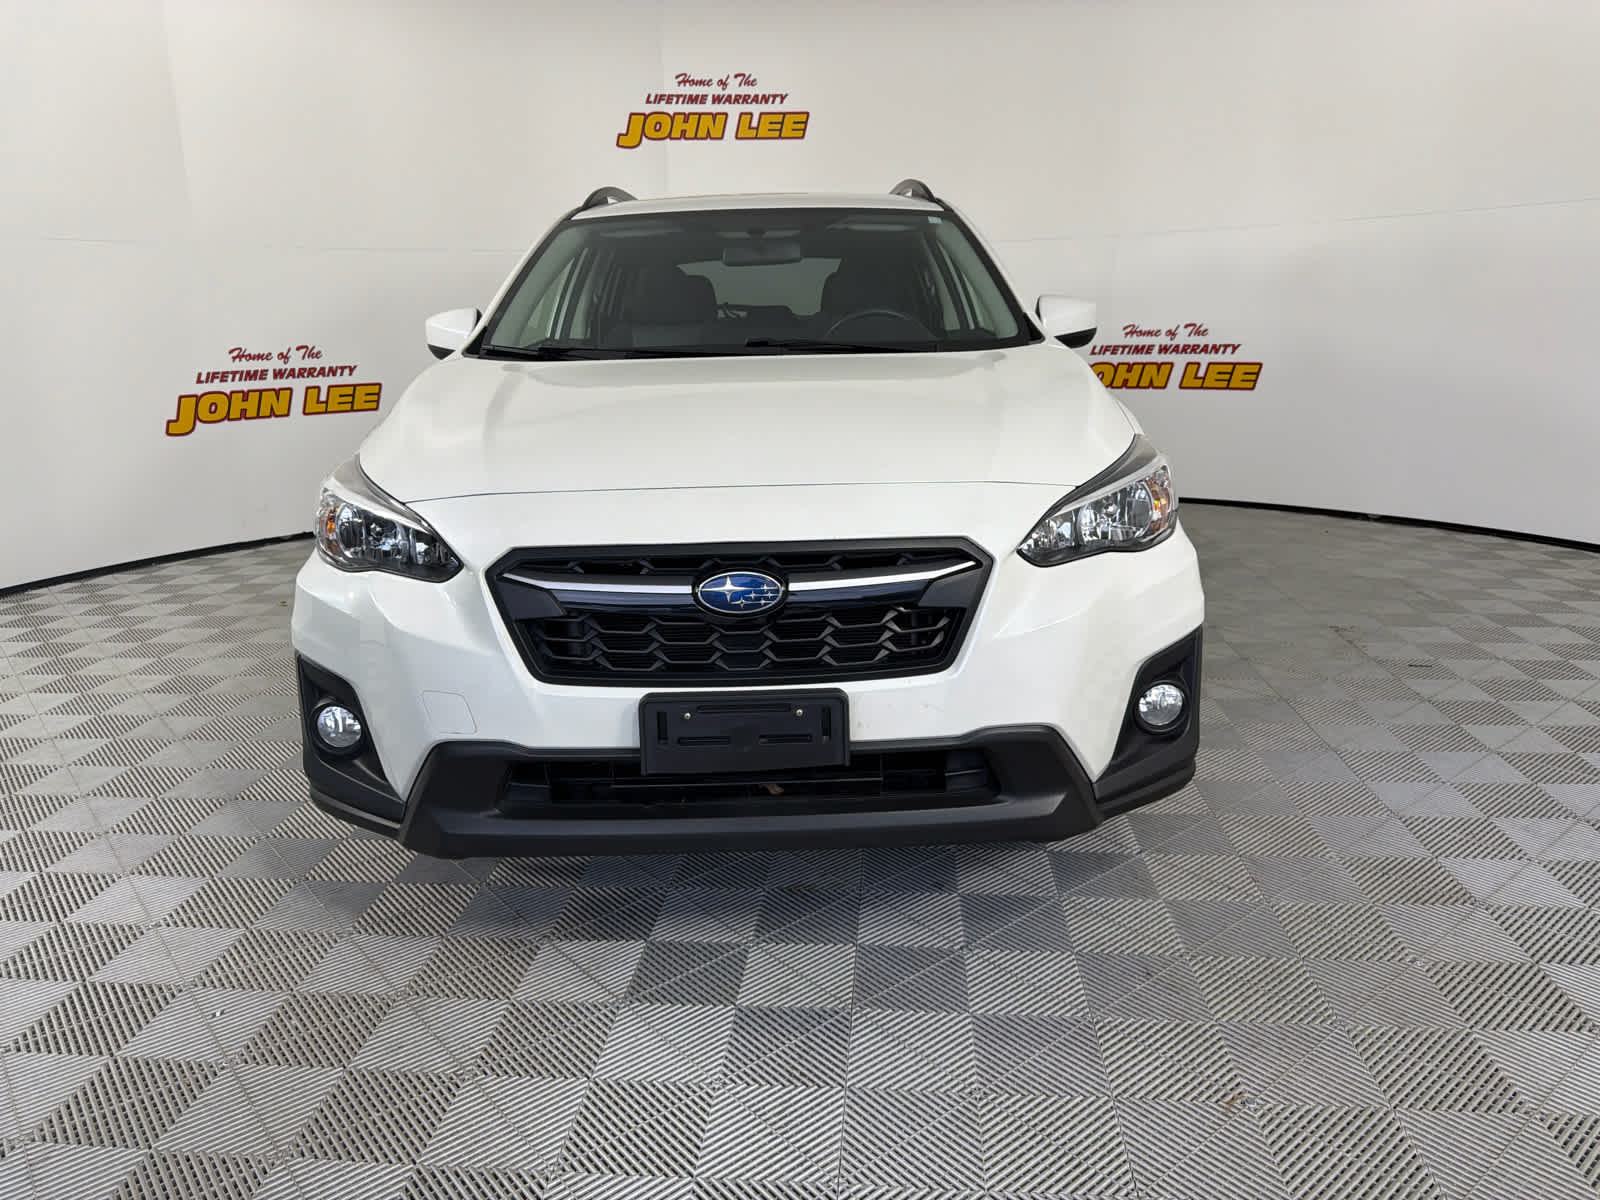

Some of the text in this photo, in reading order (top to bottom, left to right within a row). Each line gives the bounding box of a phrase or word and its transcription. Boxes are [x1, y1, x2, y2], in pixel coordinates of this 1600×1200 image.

[675, 73, 758, 91] Home of The
[645, 93, 788, 105] LIFETIME WARRANTY
[616, 111, 810, 149] JOHN LEE
[1122, 323, 1209, 339] Home of The
[228, 345, 323, 365] Home of The
[1090, 343, 1241, 356] LIFETIME WARRANTY
[196, 365, 357, 384] LIFETIME WARRANTY
[1089, 361, 1263, 391] OHN LEE
[165, 382, 382, 437] JOHN LEE
